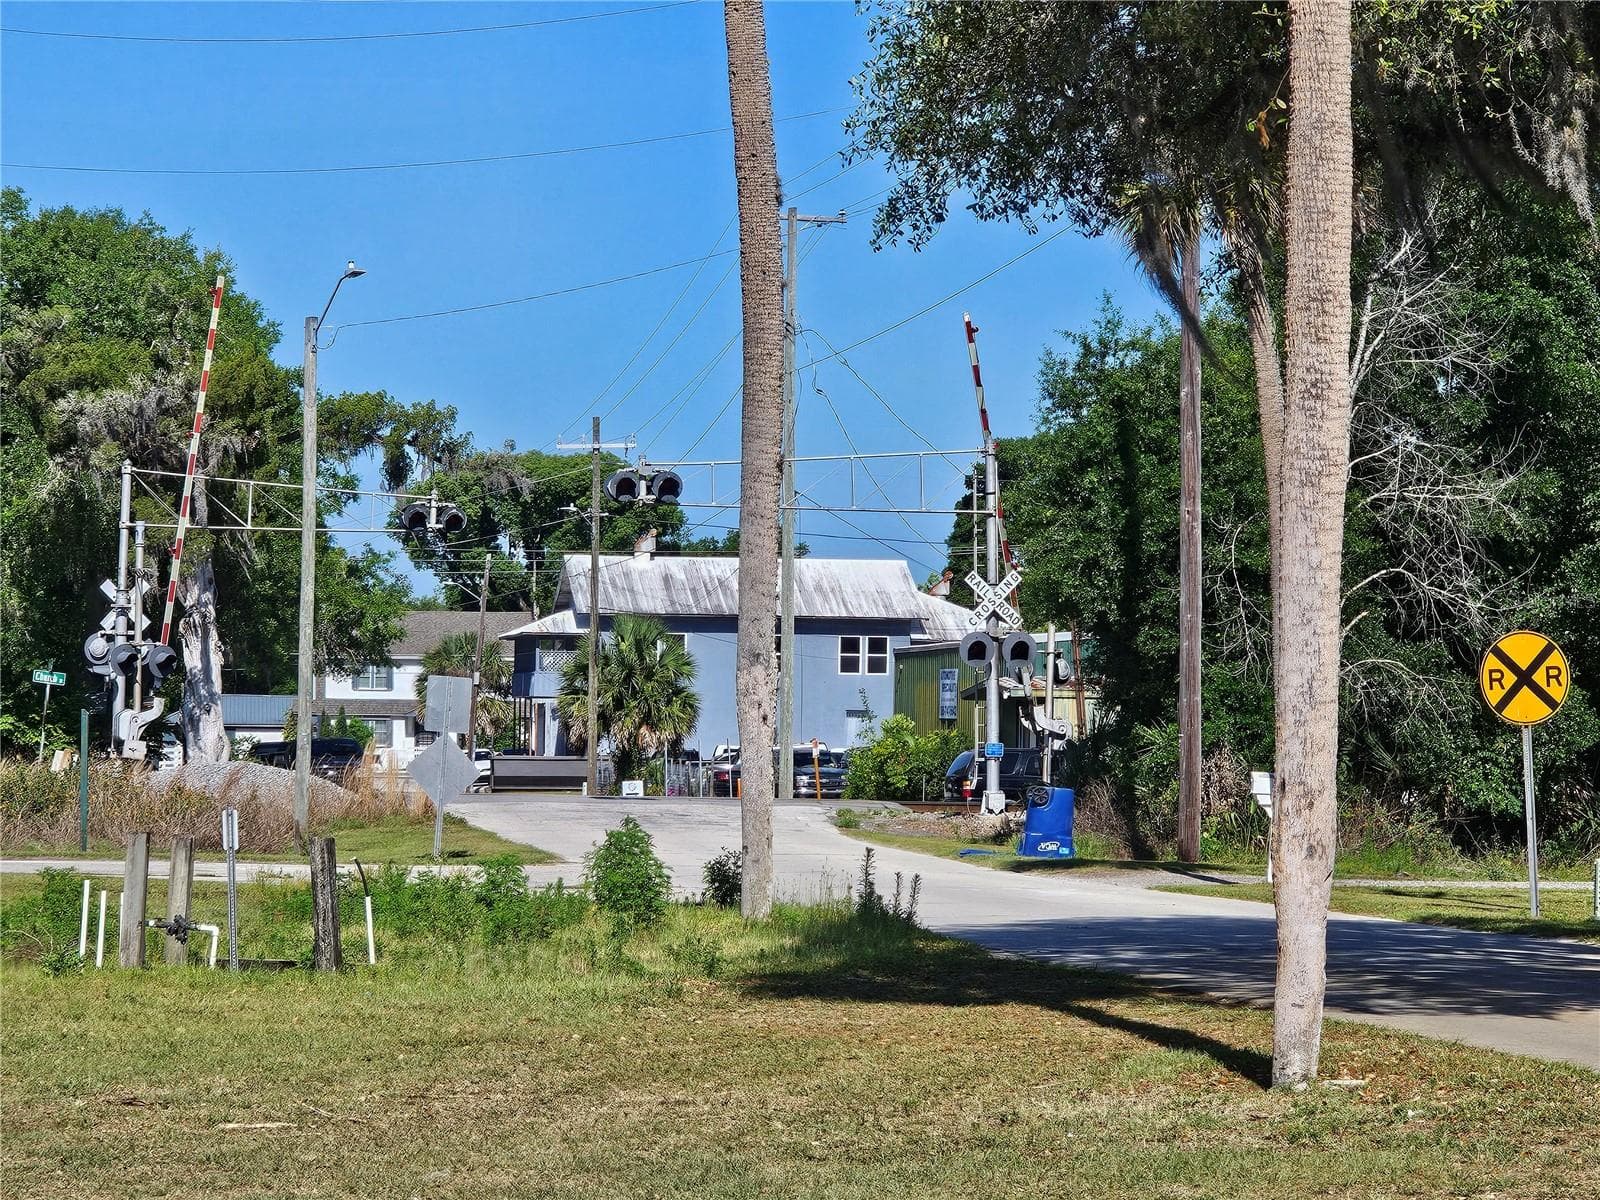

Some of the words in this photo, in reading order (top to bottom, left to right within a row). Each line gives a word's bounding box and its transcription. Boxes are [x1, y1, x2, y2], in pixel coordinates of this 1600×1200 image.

[968, 573, 1020, 626] CROSSING
[35, 671, 58, 683] Church
[1488, 668, 1505, 690] R
[1546, 665, 1562, 688] R
